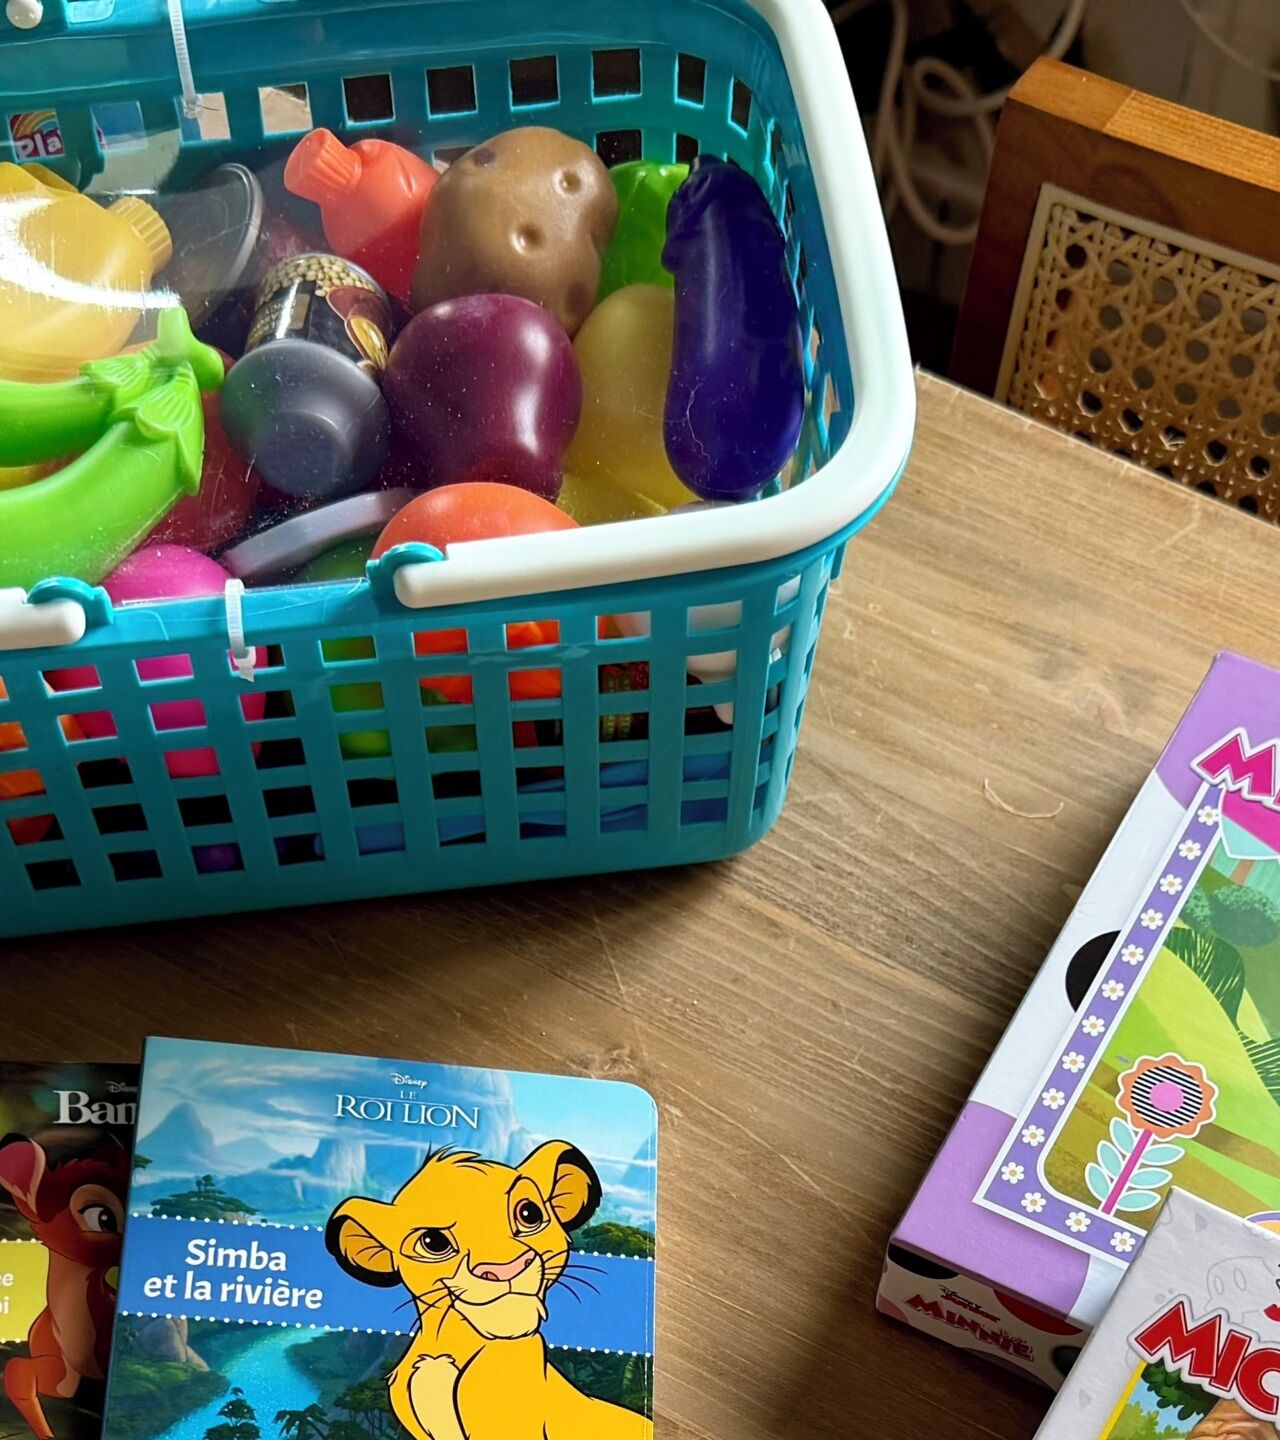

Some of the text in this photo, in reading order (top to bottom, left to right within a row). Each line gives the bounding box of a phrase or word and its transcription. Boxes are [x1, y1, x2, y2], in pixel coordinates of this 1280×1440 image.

[390, 1072, 428, 1089] Disney
[400, 1090, 417, 1100] LE
[334, 1094, 480, 1129] ROI LION
[185, 1238, 287, 1272] Simba
[143, 1270, 324, 1310] et la rivière
